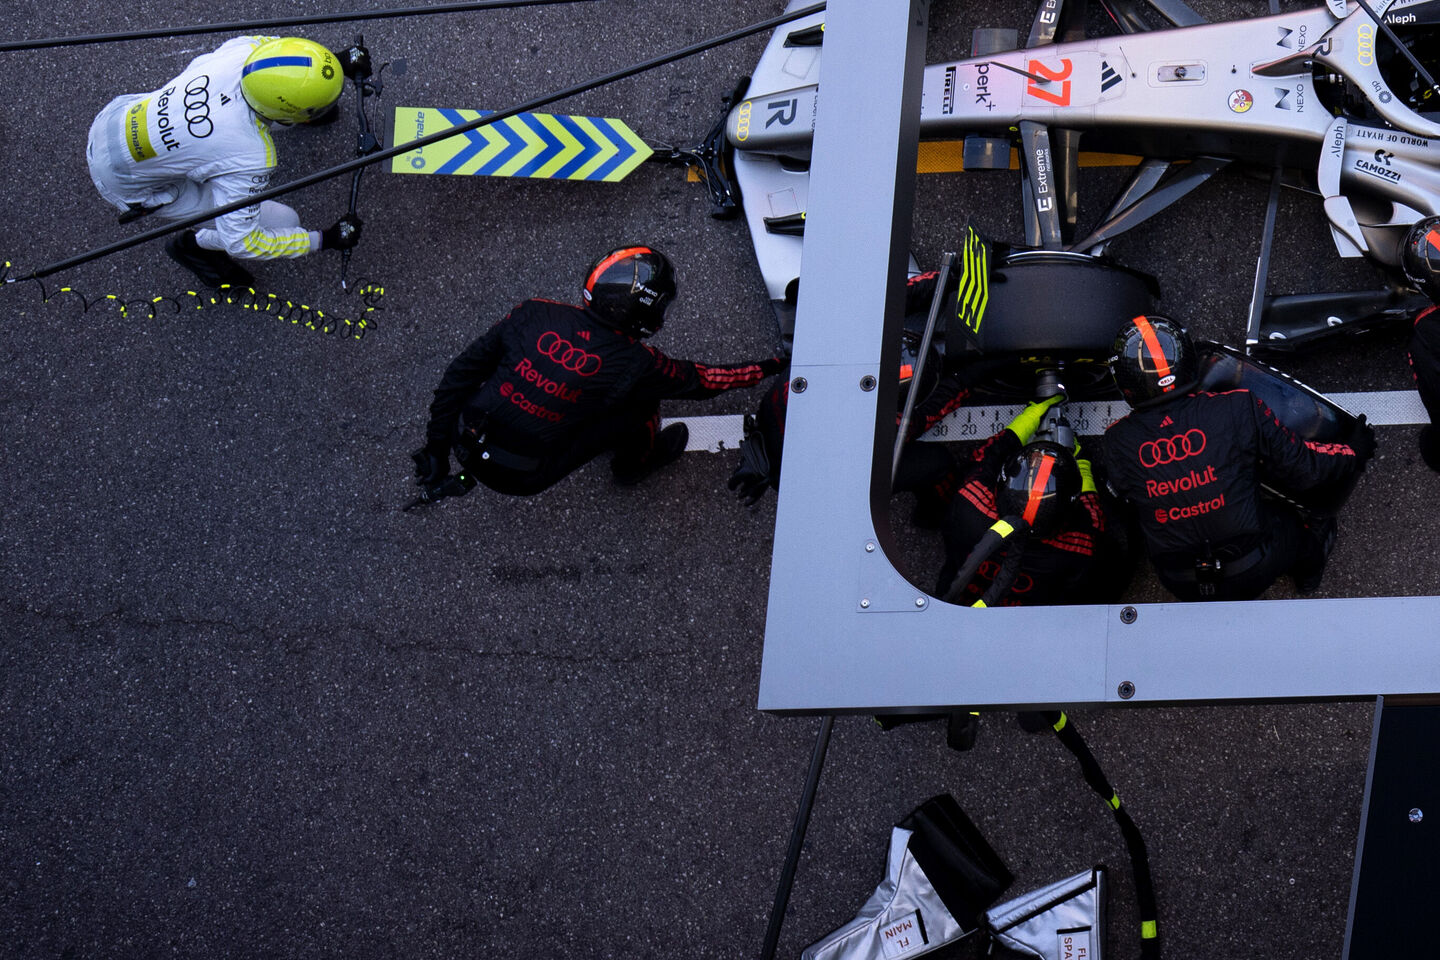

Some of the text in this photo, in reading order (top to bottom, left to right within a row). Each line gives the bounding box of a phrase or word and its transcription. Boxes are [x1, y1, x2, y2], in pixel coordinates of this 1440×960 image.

[1384, 13, 1416, 25] Aleph
[1298, 24, 1307, 52] NEXO
[325, 51, 334, 66] bp
[942, 66, 957, 114] PIRELLI
[975, 63, 992, 104] perk
[1027, 58, 1073, 107] 27
[1297, 83, 1305, 113] NEXO
[158, 87, 181, 152] Revolut
[415, 111, 425, 154] uimate
[131, 115, 145, 159] ultimate
[1331, 125, 1344, 158] Aleph
[1356, 129, 1429, 148] WORLD OF HYATT
[1036, 149, 1048, 194] Extreme
[1356, 158, 1401, 182] CAMOZZI
[514, 357, 583, 404] Revolut
[932, 425, 949, 437] 30
[961, 423, 978, 436] 20
[1073, 419, 1089, 432] 20
[1146, 464, 1218, 498] Revolut
[1168, 493, 1226, 521] Castrol
[885, 919, 913, 939] MAIN
[898, 936, 910, 949] FL
[1063, 936, 1073, 960] SPA
[1078, 948, 1086, 960] FL
